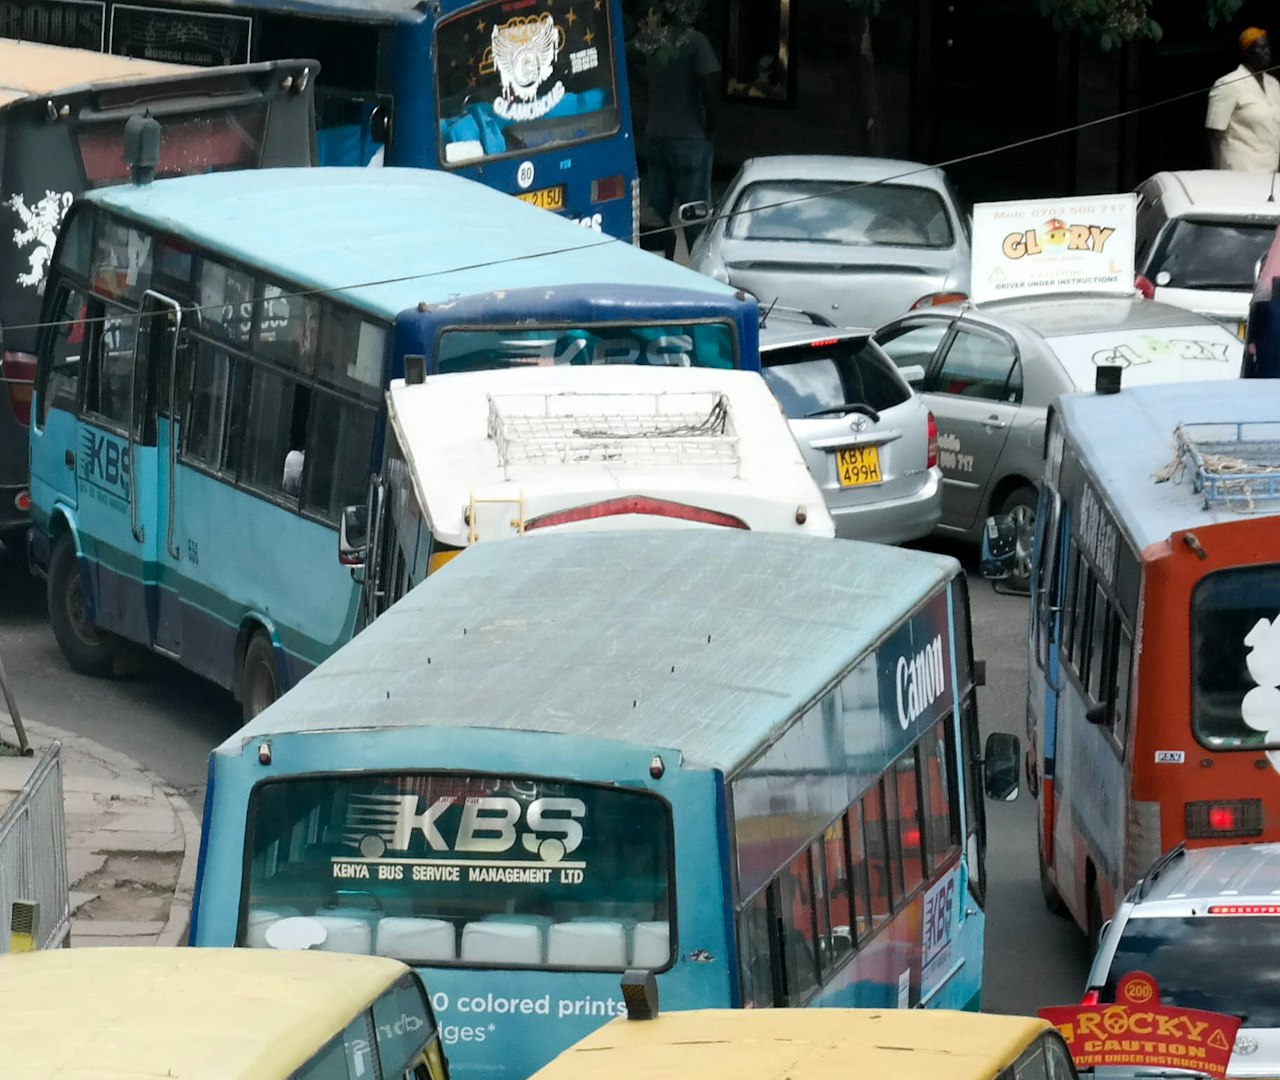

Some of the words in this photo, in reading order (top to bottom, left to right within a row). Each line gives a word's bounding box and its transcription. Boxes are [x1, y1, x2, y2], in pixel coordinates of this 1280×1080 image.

[520, 166, 532, 181] 80
[996, 281, 1025, 290] DRIVER
[1028, 279, 1055, 287] UNDER
[1058, 276, 1118, 286] INSTRUCTIONS
[839, 446, 867, 467] KBY
[843, 462, 880, 486] 499H
[896, 634, 945, 731] Canon
[390, 794, 586, 857] KBS
[333, 864, 369, 879] KENYA
[378, 865, 403, 880] BUS
[412, 866, 460, 881] SERVICE
[469, 867, 552, 883] MANAGEMENT
[560, 869, 584, 884] LTD
[927, 876, 955, 948] KBS
[1128, 985, 1149, 998] 200
[431, 991, 450, 1013] 0
[457, 993, 550, 1015] colored
[558, 995, 628, 1018] prints
[1076, 1008, 1208, 1042] ROCKY
[1085, 1040, 1206, 1058] CAUTION
[1105, 1054, 1144, 1064] UNDER
[1146, 1056, 1225, 1073] INSTRUCTION
